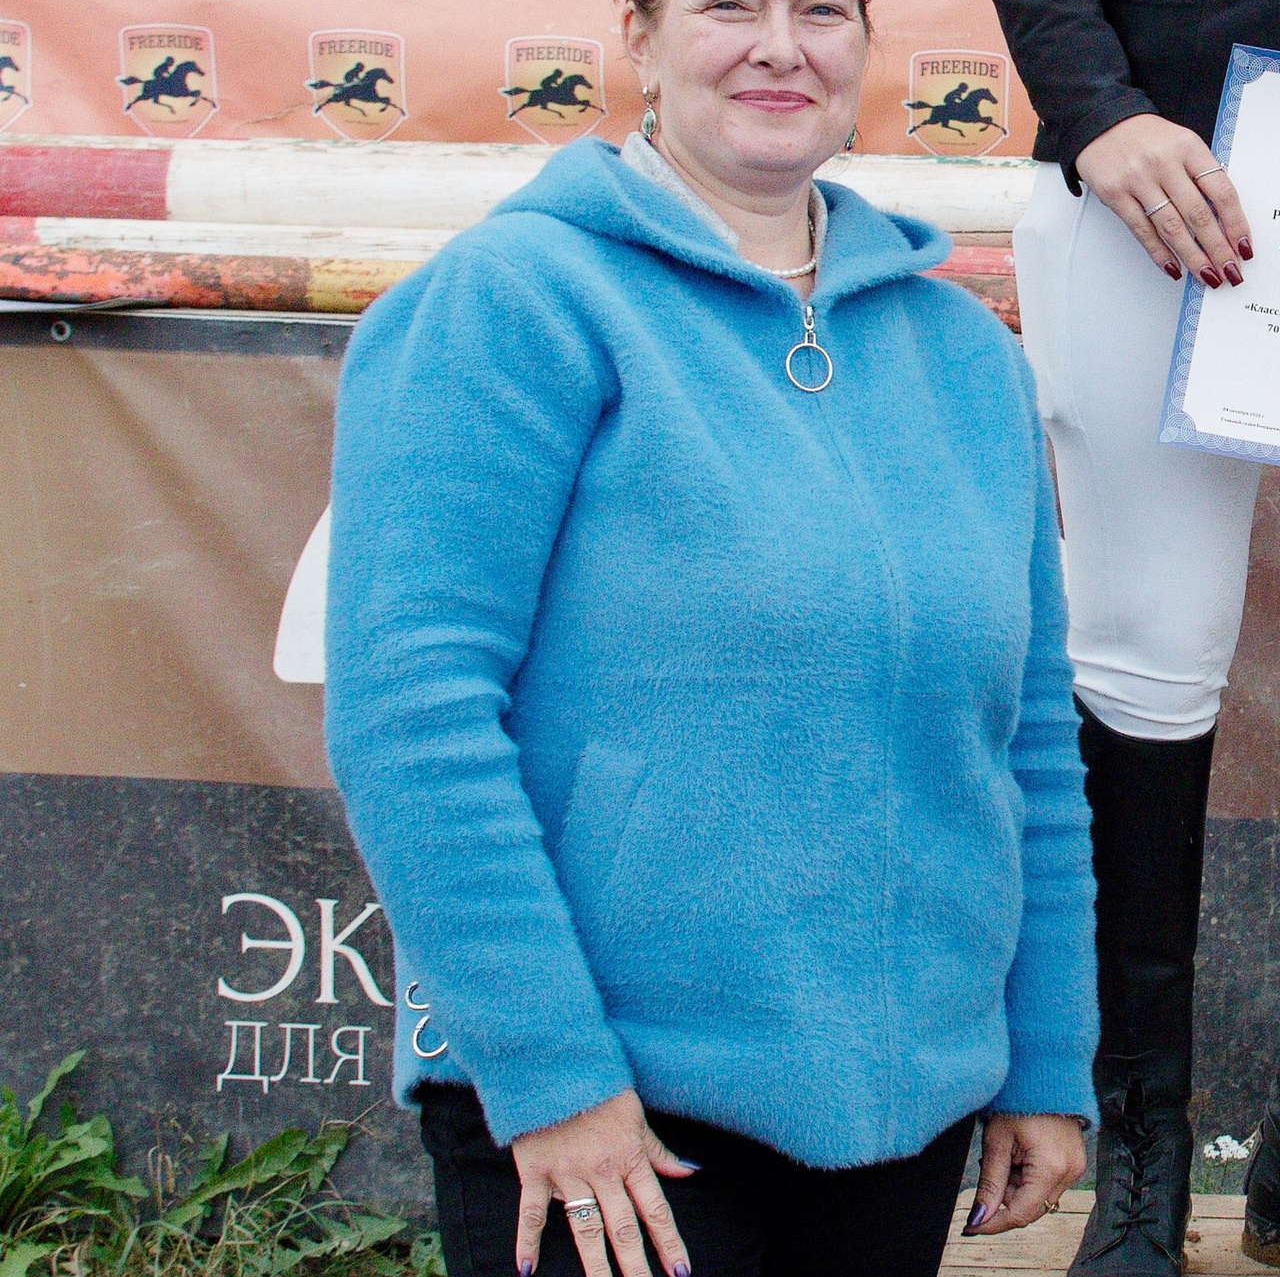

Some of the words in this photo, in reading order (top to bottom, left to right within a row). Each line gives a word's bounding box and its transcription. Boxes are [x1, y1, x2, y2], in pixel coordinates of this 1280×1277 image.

[319, 40, 397, 57] FREERIDE
[515, 47, 593, 64] FREERIDE
[919, 61, 999, 80] FREERIDE
[1267, 324, 1280, 333] 70
